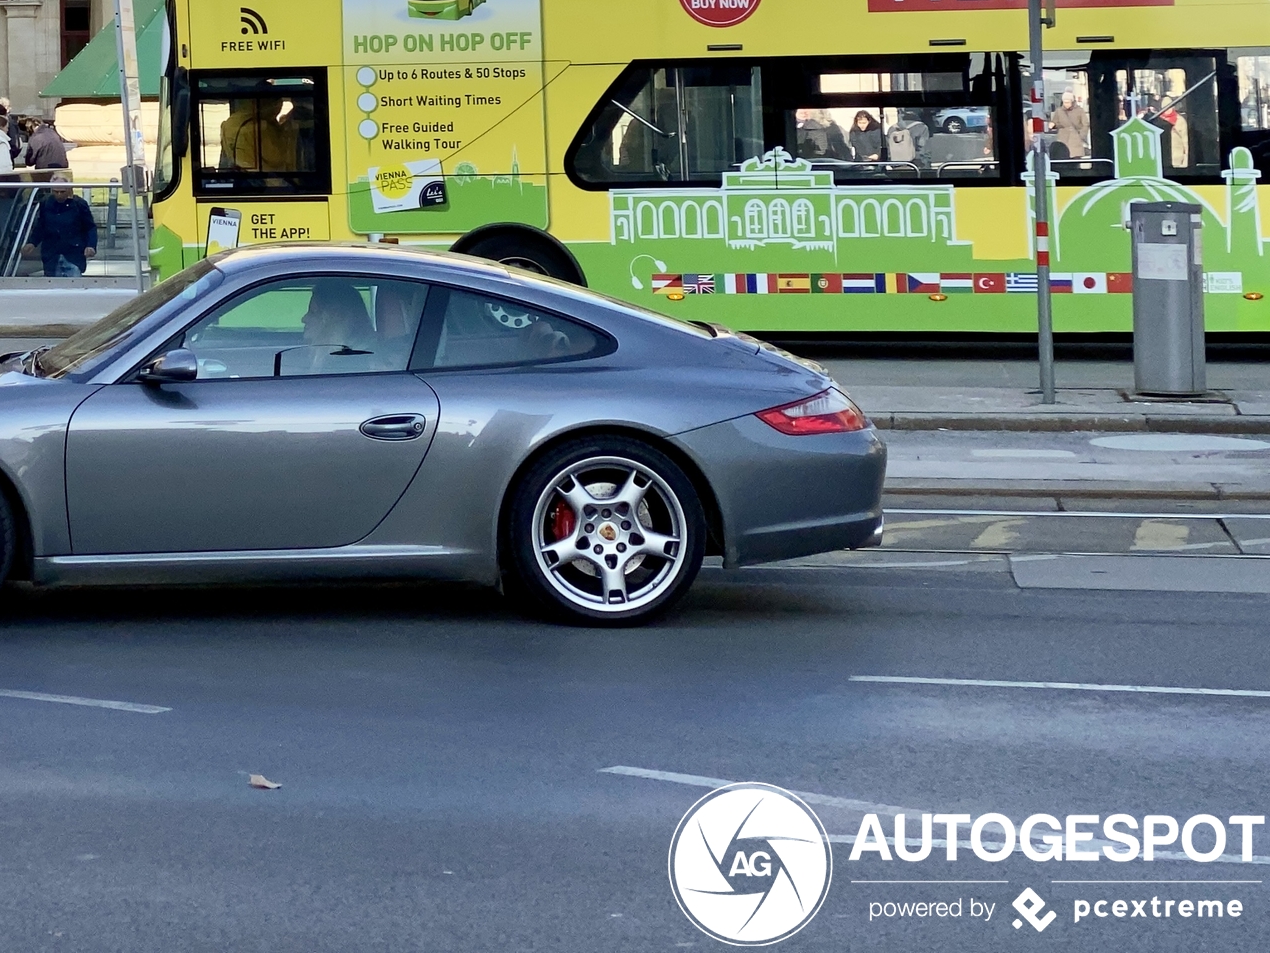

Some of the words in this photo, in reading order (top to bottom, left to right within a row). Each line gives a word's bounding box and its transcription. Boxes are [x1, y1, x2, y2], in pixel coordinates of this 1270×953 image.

[221, 41, 253, 52] FREE
[257, 40, 285, 51] WIFI
[353, 34, 398, 54] HOP
[403, 33, 434, 53] ON
[440, 32, 485, 52] HOP
[490, 31, 532, 51] OFF
[379, 69, 394, 82] Up
[396, 70, 408, 80] to
[411, 69, 418, 79] 6
[421, 68, 461, 79] Routes
[464, 68, 473, 78] &
[476, 67, 490, 78] 50
[493, 67, 526, 80] Stops
[380, 96, 413, 107] Short
[416, 95, 461, 108] Waiting
[465, 94, 501, 105] Times
[382, 123, 409, 133] Free
[412, 121, 454, 133] Guided
[382, 139, 430, 152] Walking
[434, 138, 461, 150] Tour
[375, 170, 407, 181] VIENNA
[381, 176, 413, 192] PASS
[212, 218, 237, 227] VIENNA
[251, 214, 275, 225] GET
[252, 228, 277, 238] THE
[280, 228, 310, 238] APP!
